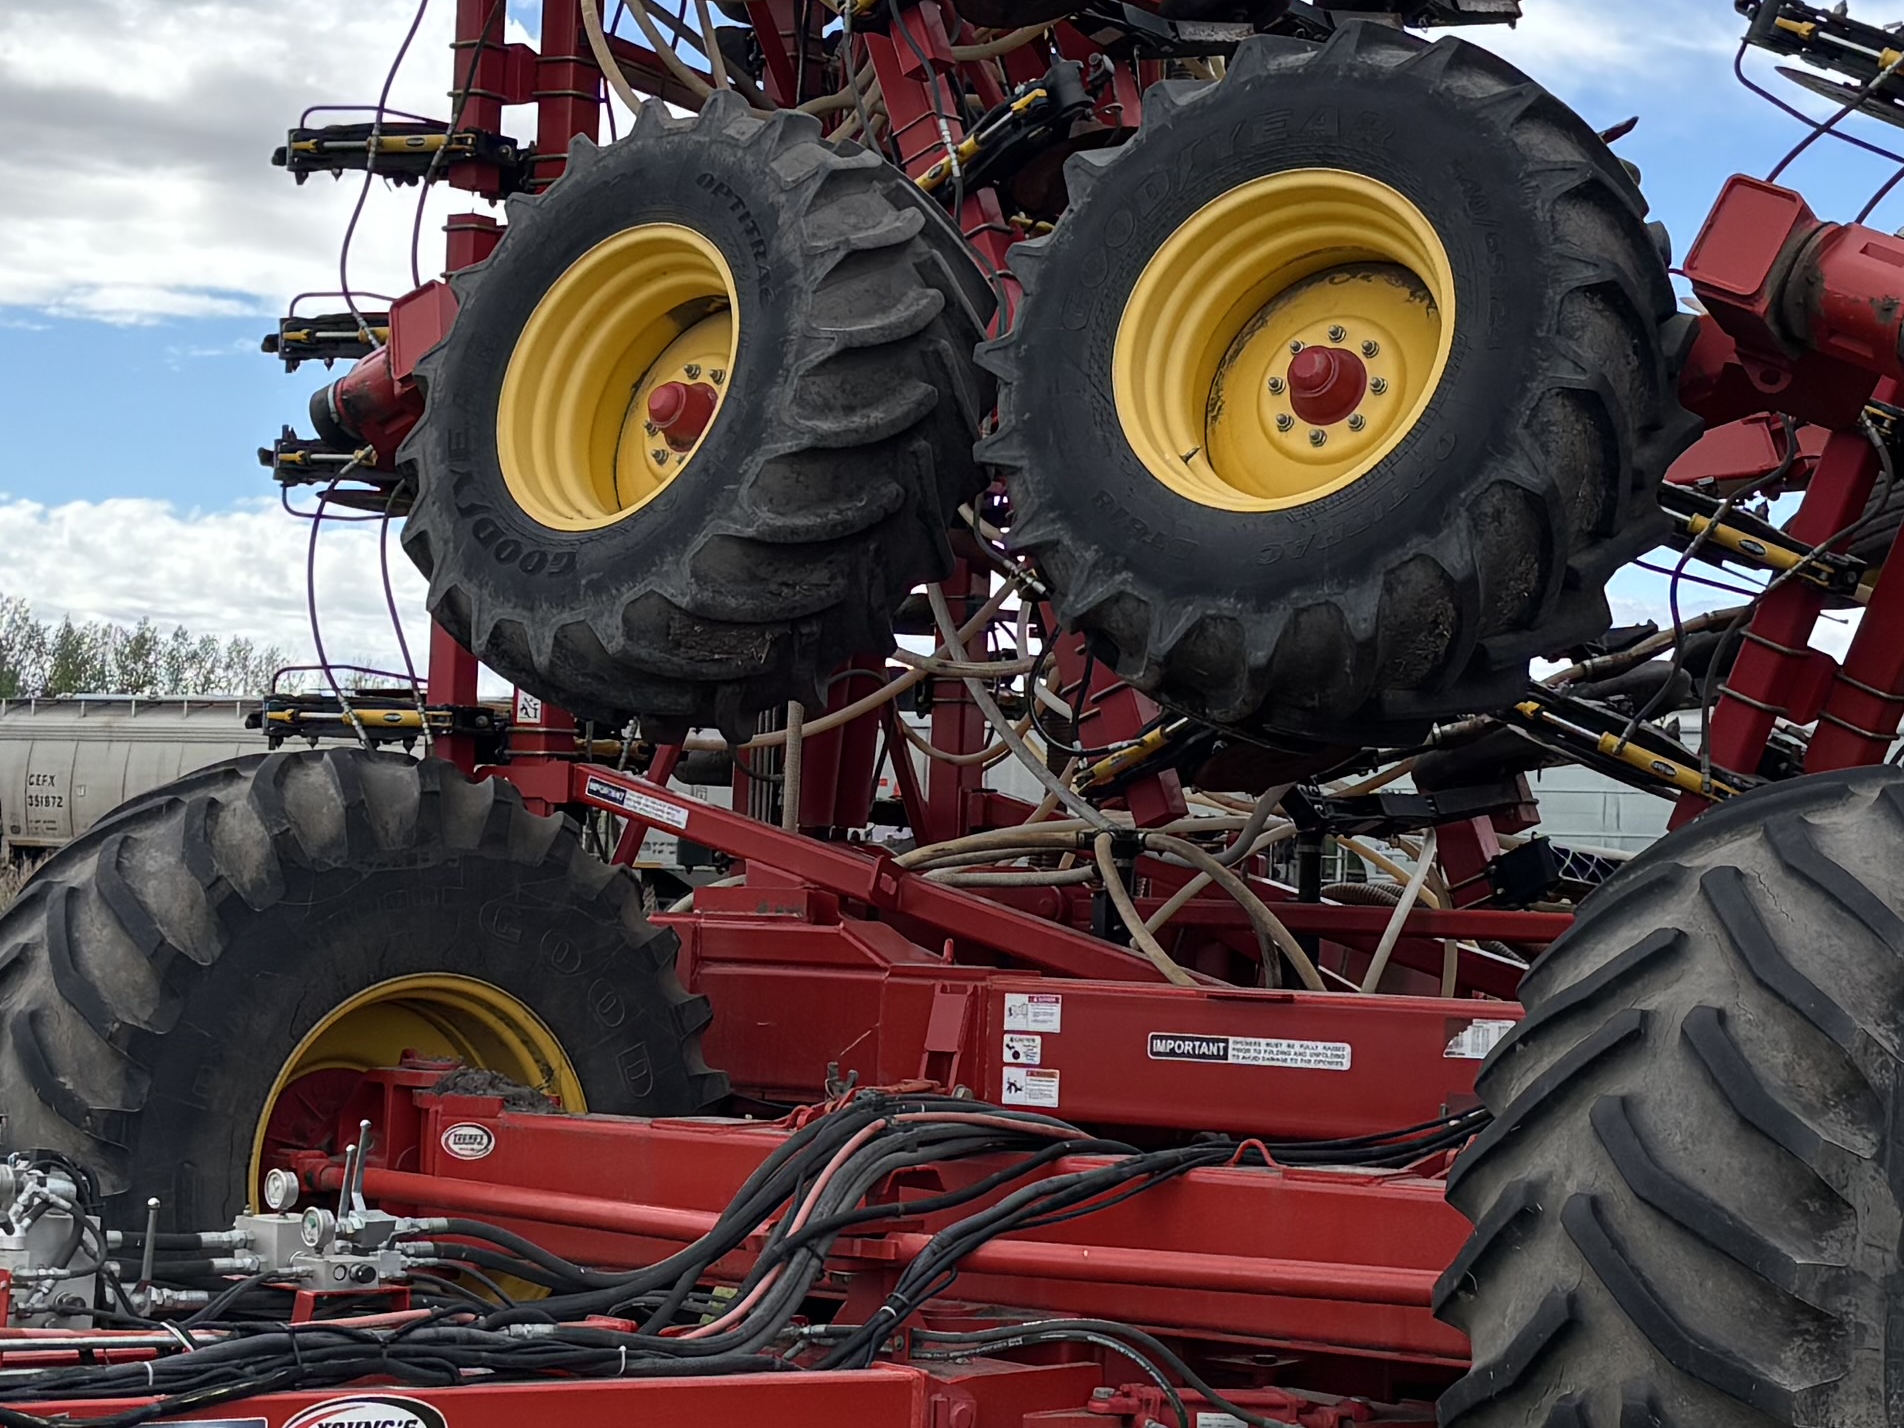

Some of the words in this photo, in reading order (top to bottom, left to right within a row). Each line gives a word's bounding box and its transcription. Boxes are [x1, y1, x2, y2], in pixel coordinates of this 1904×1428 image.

[695, 172, 775, 308] OPTITRAC
[1061, 105, 1396, 332] GOODYEAR
[1153, 1039, 1226, 1056] IMPORTANT
